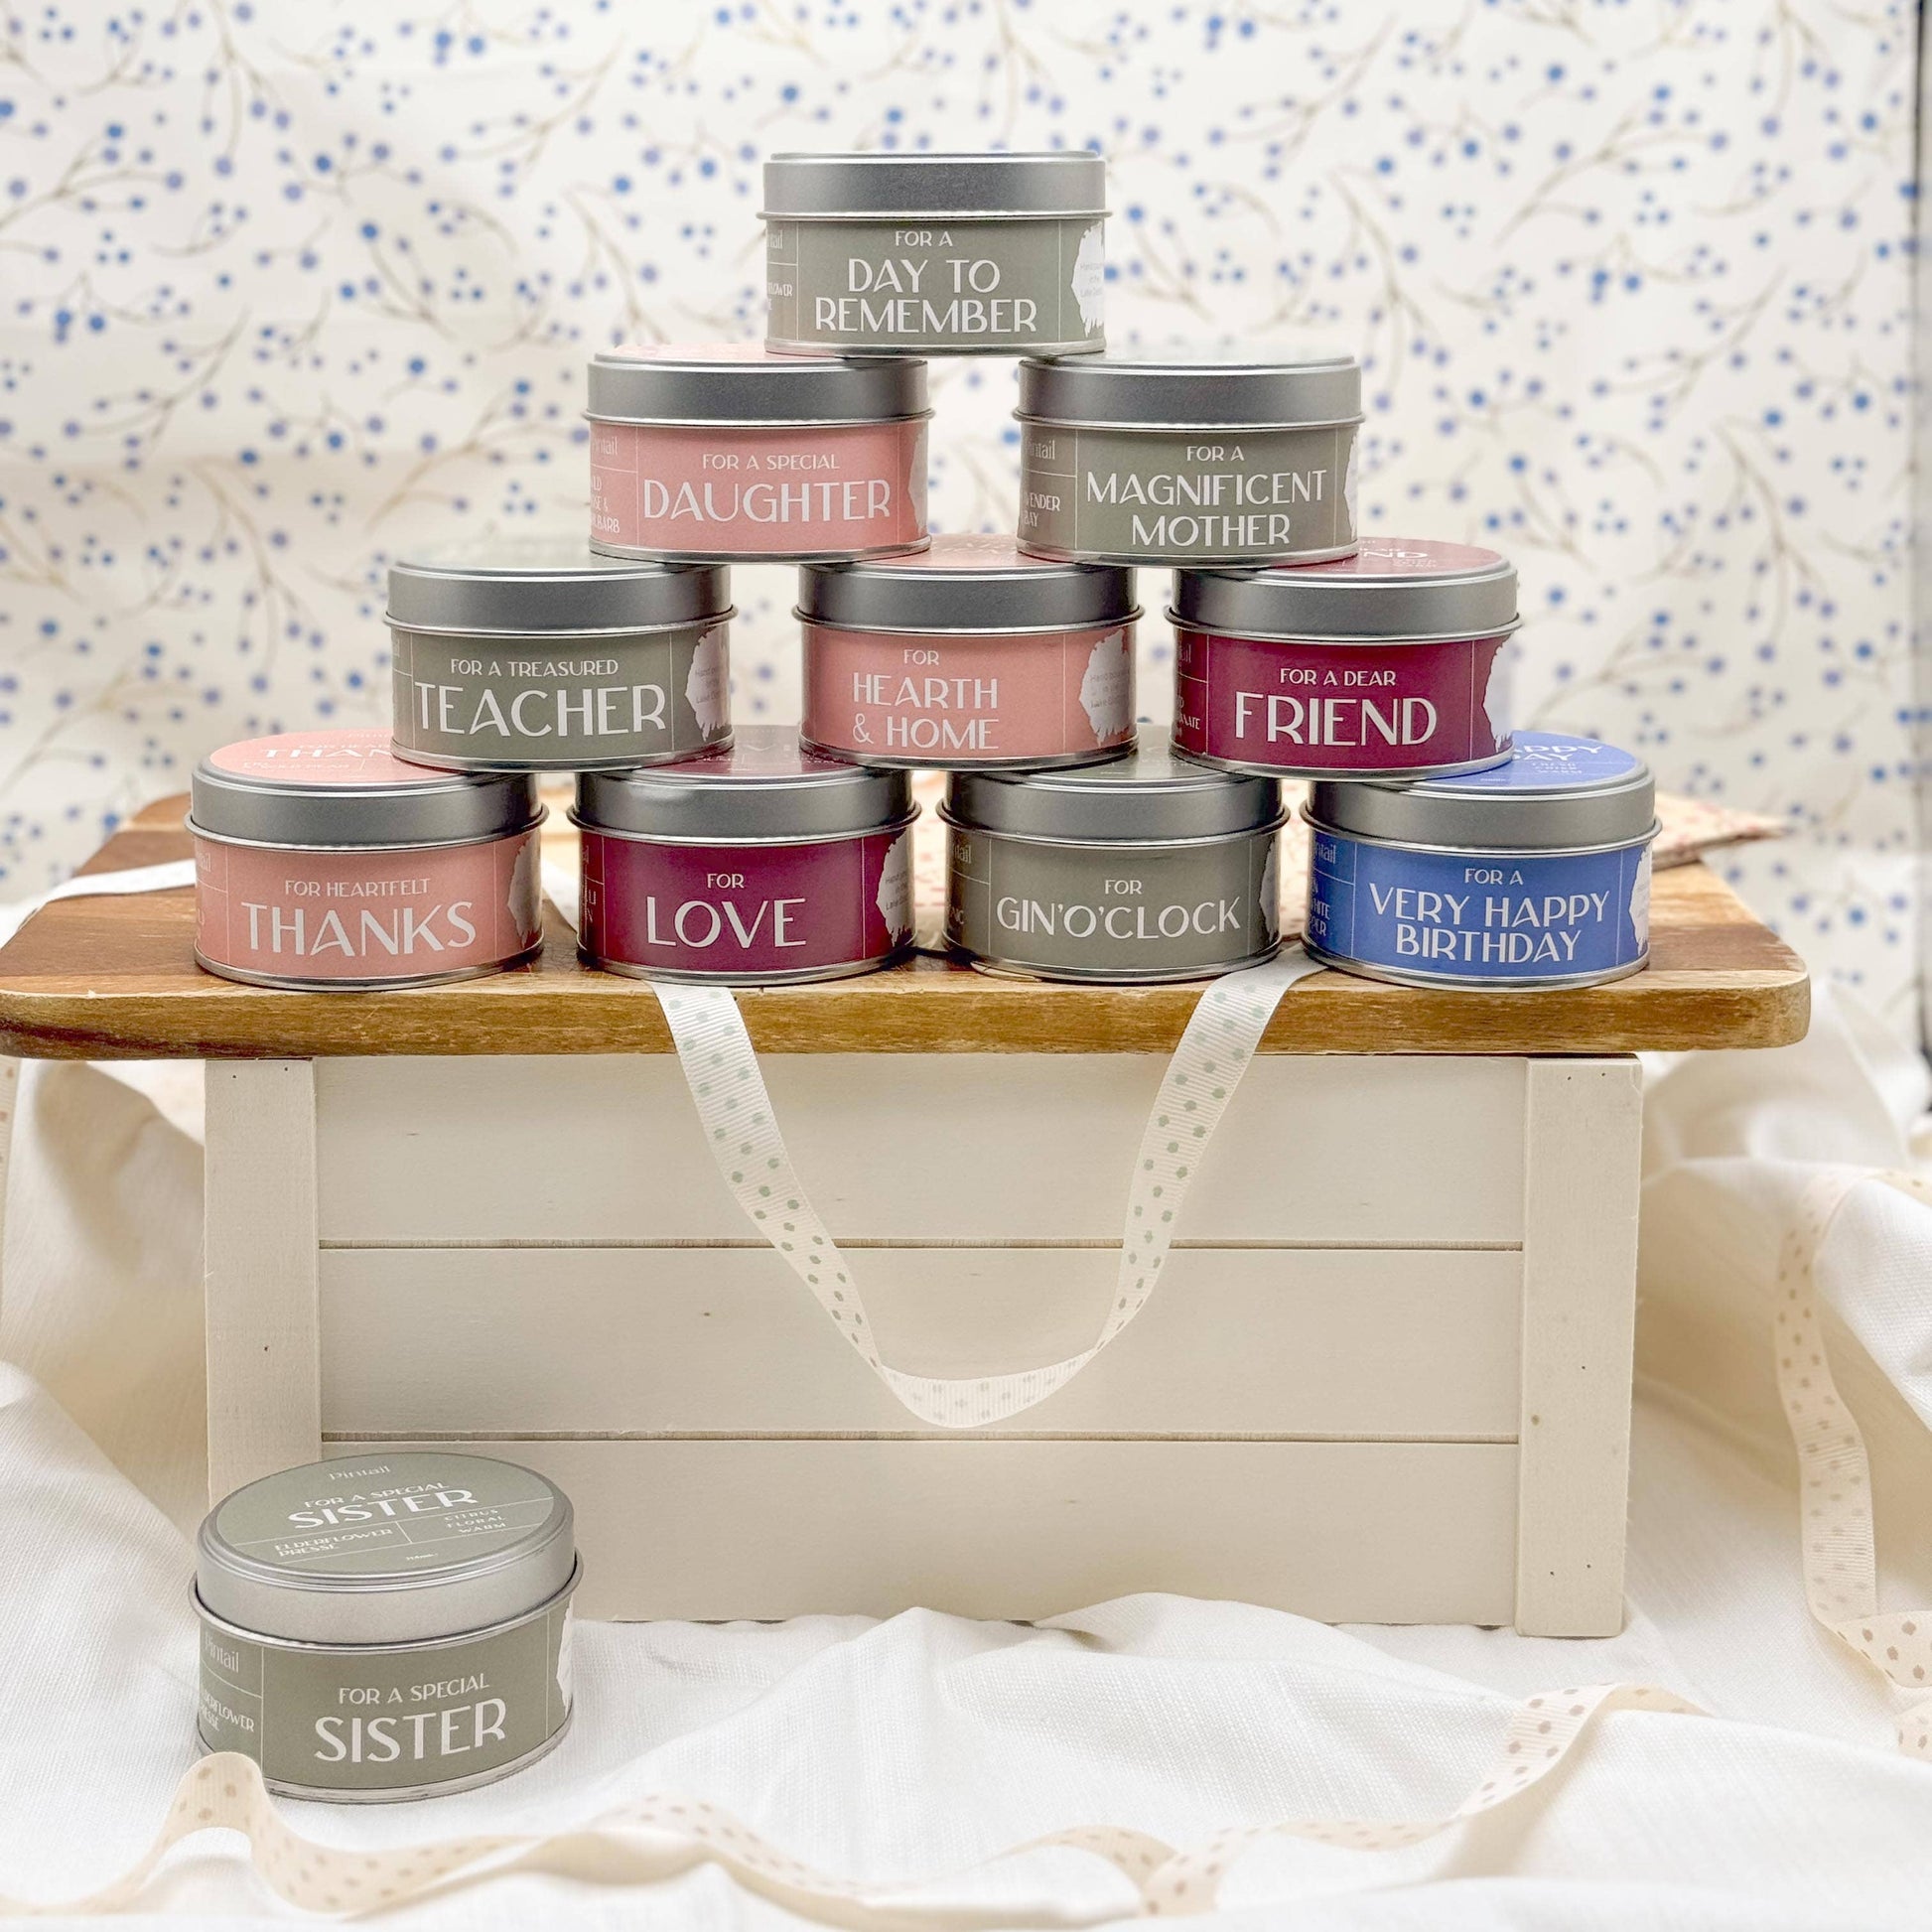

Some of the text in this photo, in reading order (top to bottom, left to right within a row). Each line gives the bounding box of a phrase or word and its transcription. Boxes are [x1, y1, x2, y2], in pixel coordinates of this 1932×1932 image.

[895, 230, 953, 247] FOR A
[848, 258, 1001, 294] DAY TO
[815, 298, 1036, 334] REMEMBER
[703, 454, 841, 471] FOR A SPECIAL
[1186, 446, 1244, 462] FOR A
[644, 479, 891, 523] DAUGHTER
[1086, 470, 1327, 506] MAGNIFICENT
[1132, 513, 1290, 547] MOTHER
[451, 658, 619, 678] FOR A TREASURED
[903, 649, 939, 666] FOR
[853, 671, 998, 710] HEARTH
[1280, 667, 1396, 687] FOR A DEAR
[414, 681, 666, 737] TEACHER
[1235, 691, 1437, 747] FRIEND
[852, 713, 999, 750] & HOME
[285, 878, 431, 897] FOR HEARTFELT
[707, 873, 745, 889] FOR
[1104, 880, 1142, 895] FOR
[1464, 868, 1523, 886] FOR A
[646, 896, 806, 949] LOVE
[1369, 883, 1609, 928] VERY HAPPY
[241, 901, 477, 956] THANKS
[1396, 923, 1582, 963] BIRTHDAY
[329, 1465, 391, 1481] Pintail
[288, 1489, 479, 1529] SISTER
[304, 1481, 450, 1509] FOR A SPECIAL
[274, 1528, 394, 1552] ELDERFLOWER
[339, 1673, 489, 1705] FOR A SPECIAL
[314, 1698, 506, 1763] SISTER
